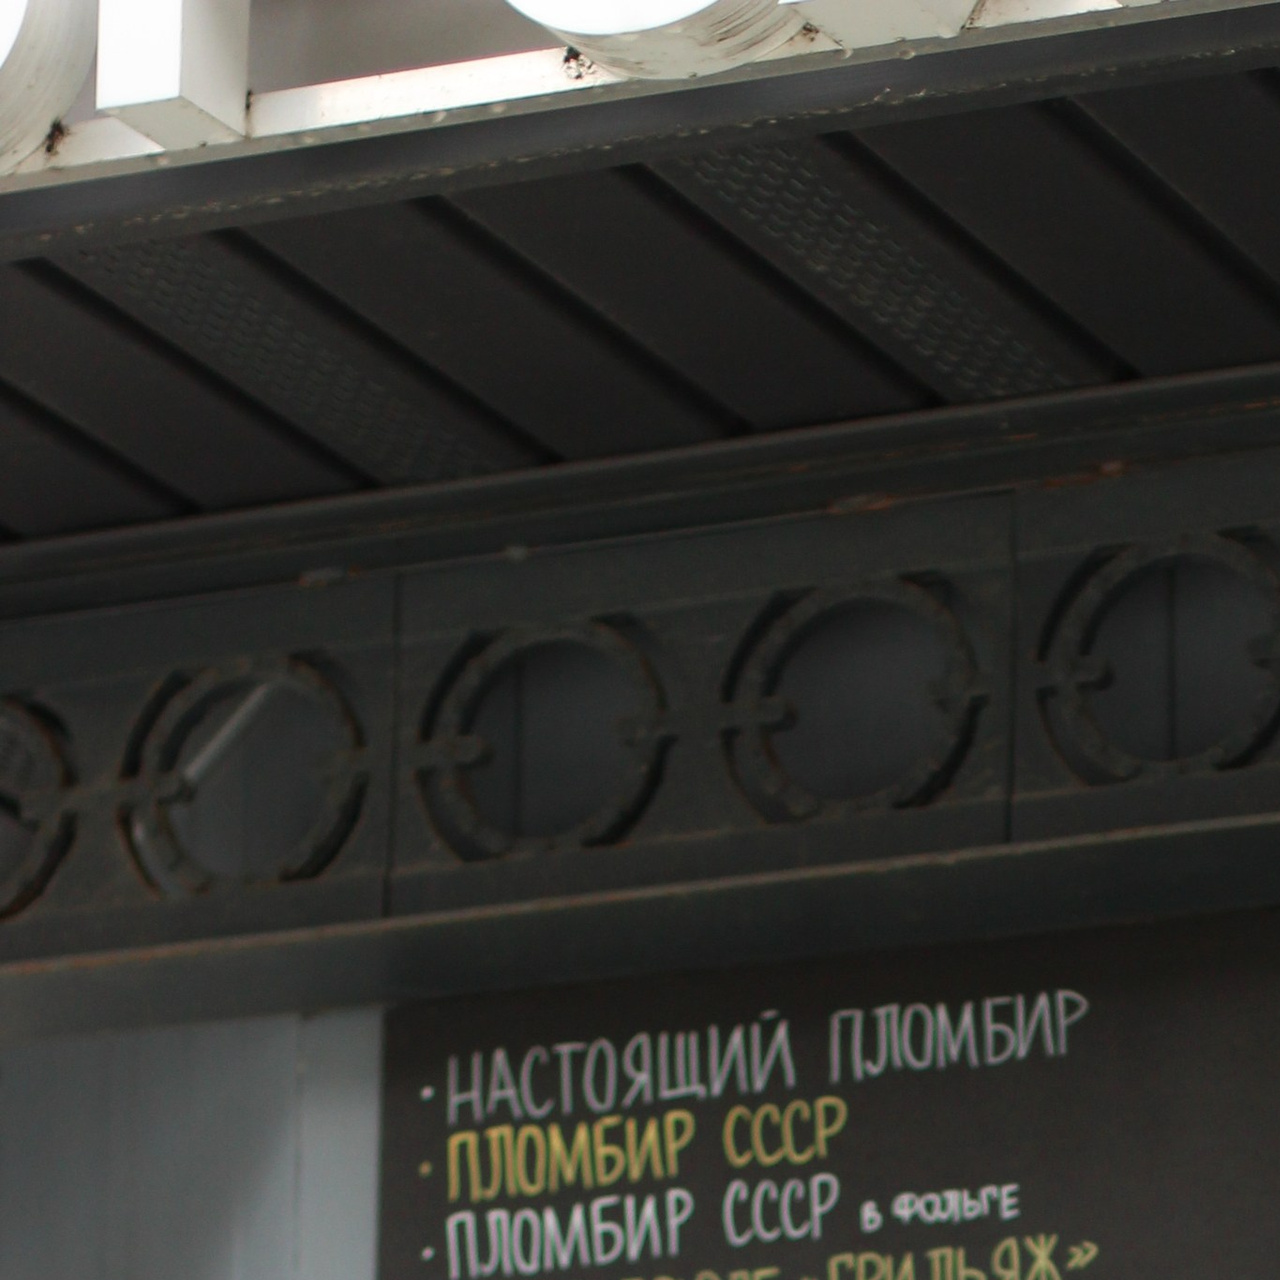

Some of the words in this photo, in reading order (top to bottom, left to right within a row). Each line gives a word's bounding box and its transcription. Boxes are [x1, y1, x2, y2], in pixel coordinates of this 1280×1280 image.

[448, 1010, 795, 1123] НАСТОЯЩИЙ
[830, 989, 1088, 1082] ПЛОМБИР
[448, 1110, 693, 1200] ПЛОМБИР
[724, 1096, 847, 1166] СССР
[445, 1188, 694, 1280] ПЛОМБИР
[723, 1173, 840, 1246] СССР
[860, 1200, 883, 1233] В
[891, 1183, 1020, 1224] ФОЛЬГЕ
